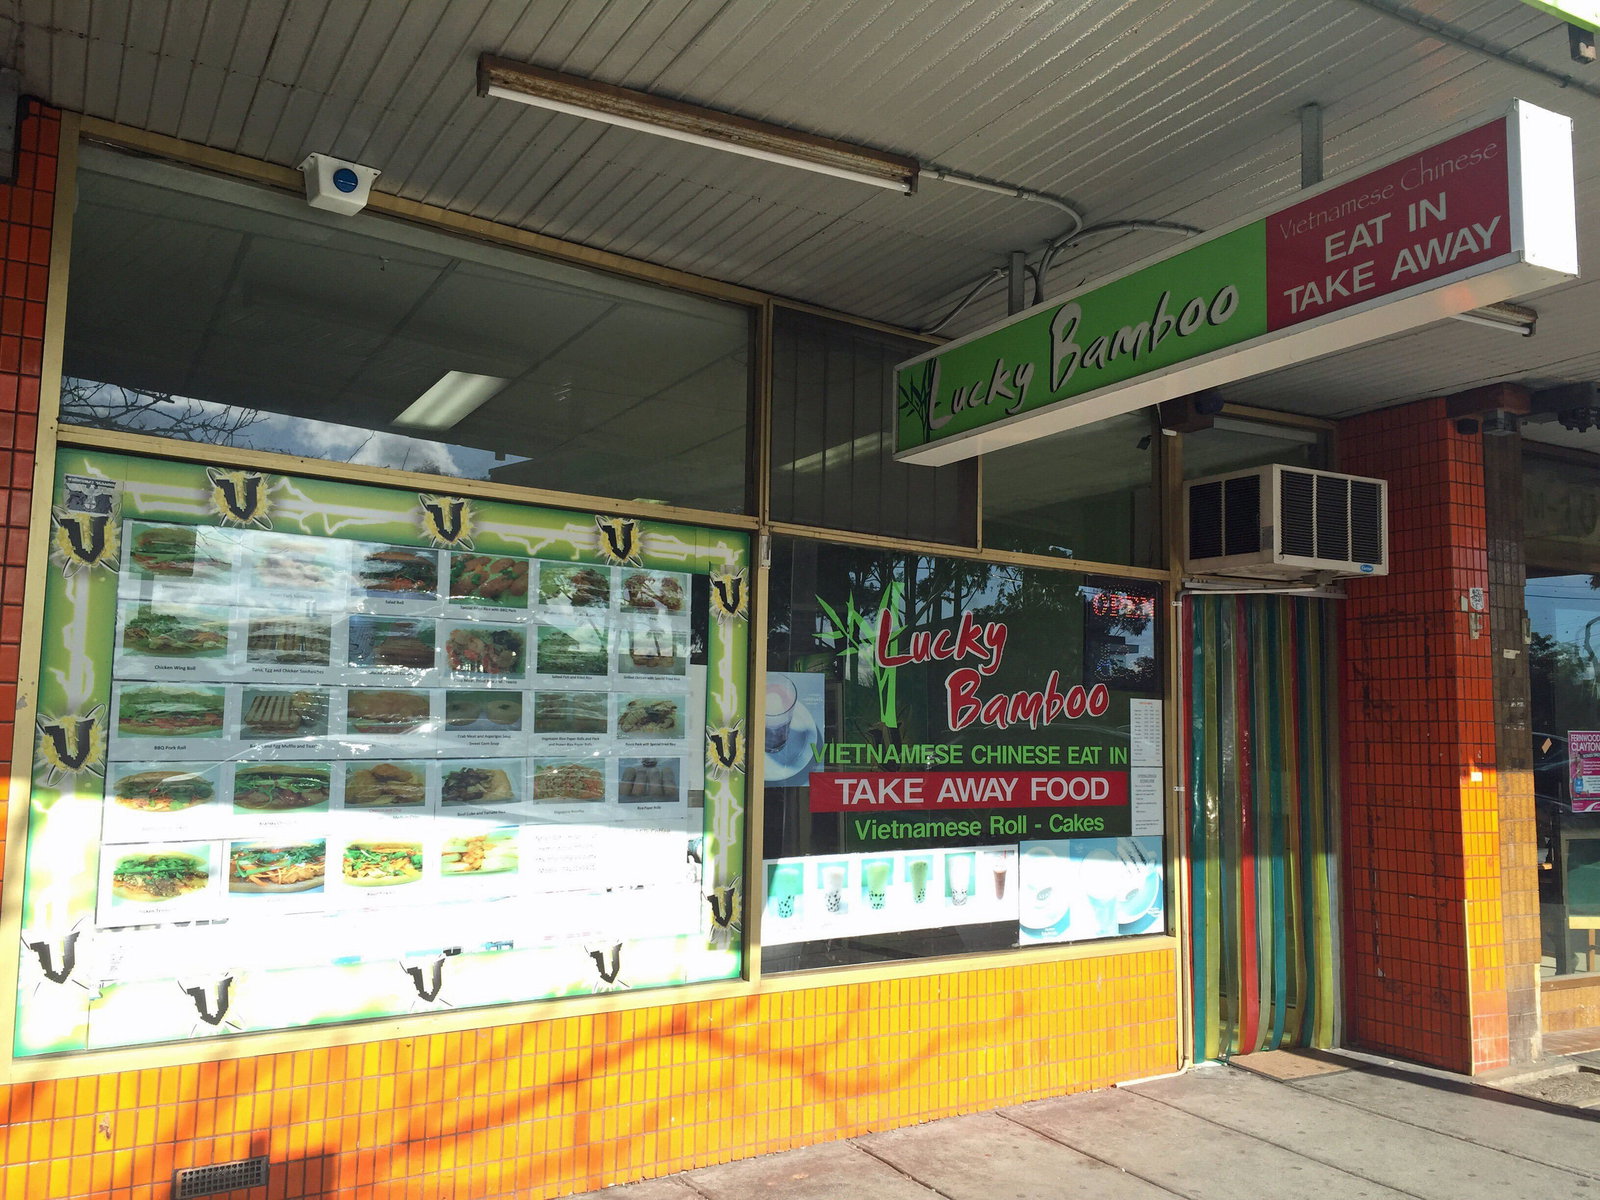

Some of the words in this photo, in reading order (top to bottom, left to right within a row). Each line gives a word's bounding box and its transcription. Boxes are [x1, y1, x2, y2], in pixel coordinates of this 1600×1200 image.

[1280, 183, 1394, 239] Vietnamese
[1400, 142, 1498, 191] Chinese
[1325, 213, 1392, 263] EAT
[1408, 192, 1447, 232] IN
[1283, 260, 1376, 314] TAKE
[1390, 215, 1502, 281] AWAY
[927, 357, 1035, 430] Lucky
[1049, 284, 1239, 393] Bamboo
[1092, 593, 1155, 619] OPEN
[875, 608, 1008, 676] Lucky
[945, 668, 1110, 732] Bamboo
[809, 743, 963, 765] VIETNAMESE
[971, 744, 1060, 765] CHINESE
[1067, 746, 1102, 765] EAT
[1109, 746, 1127, 765] IN
[1571, 742, 1600, 752] CLAYTON
[834, 778, 924, 805] TAKE
[936, 777, 1019, 803] AWAY
[1030, 777, 1110, 801] FOOD
[854, 818, 982, 840] Vietnamese
[990, 815, 1027, 836] Roll
[1049, 813, 1105, 833] Cakes
